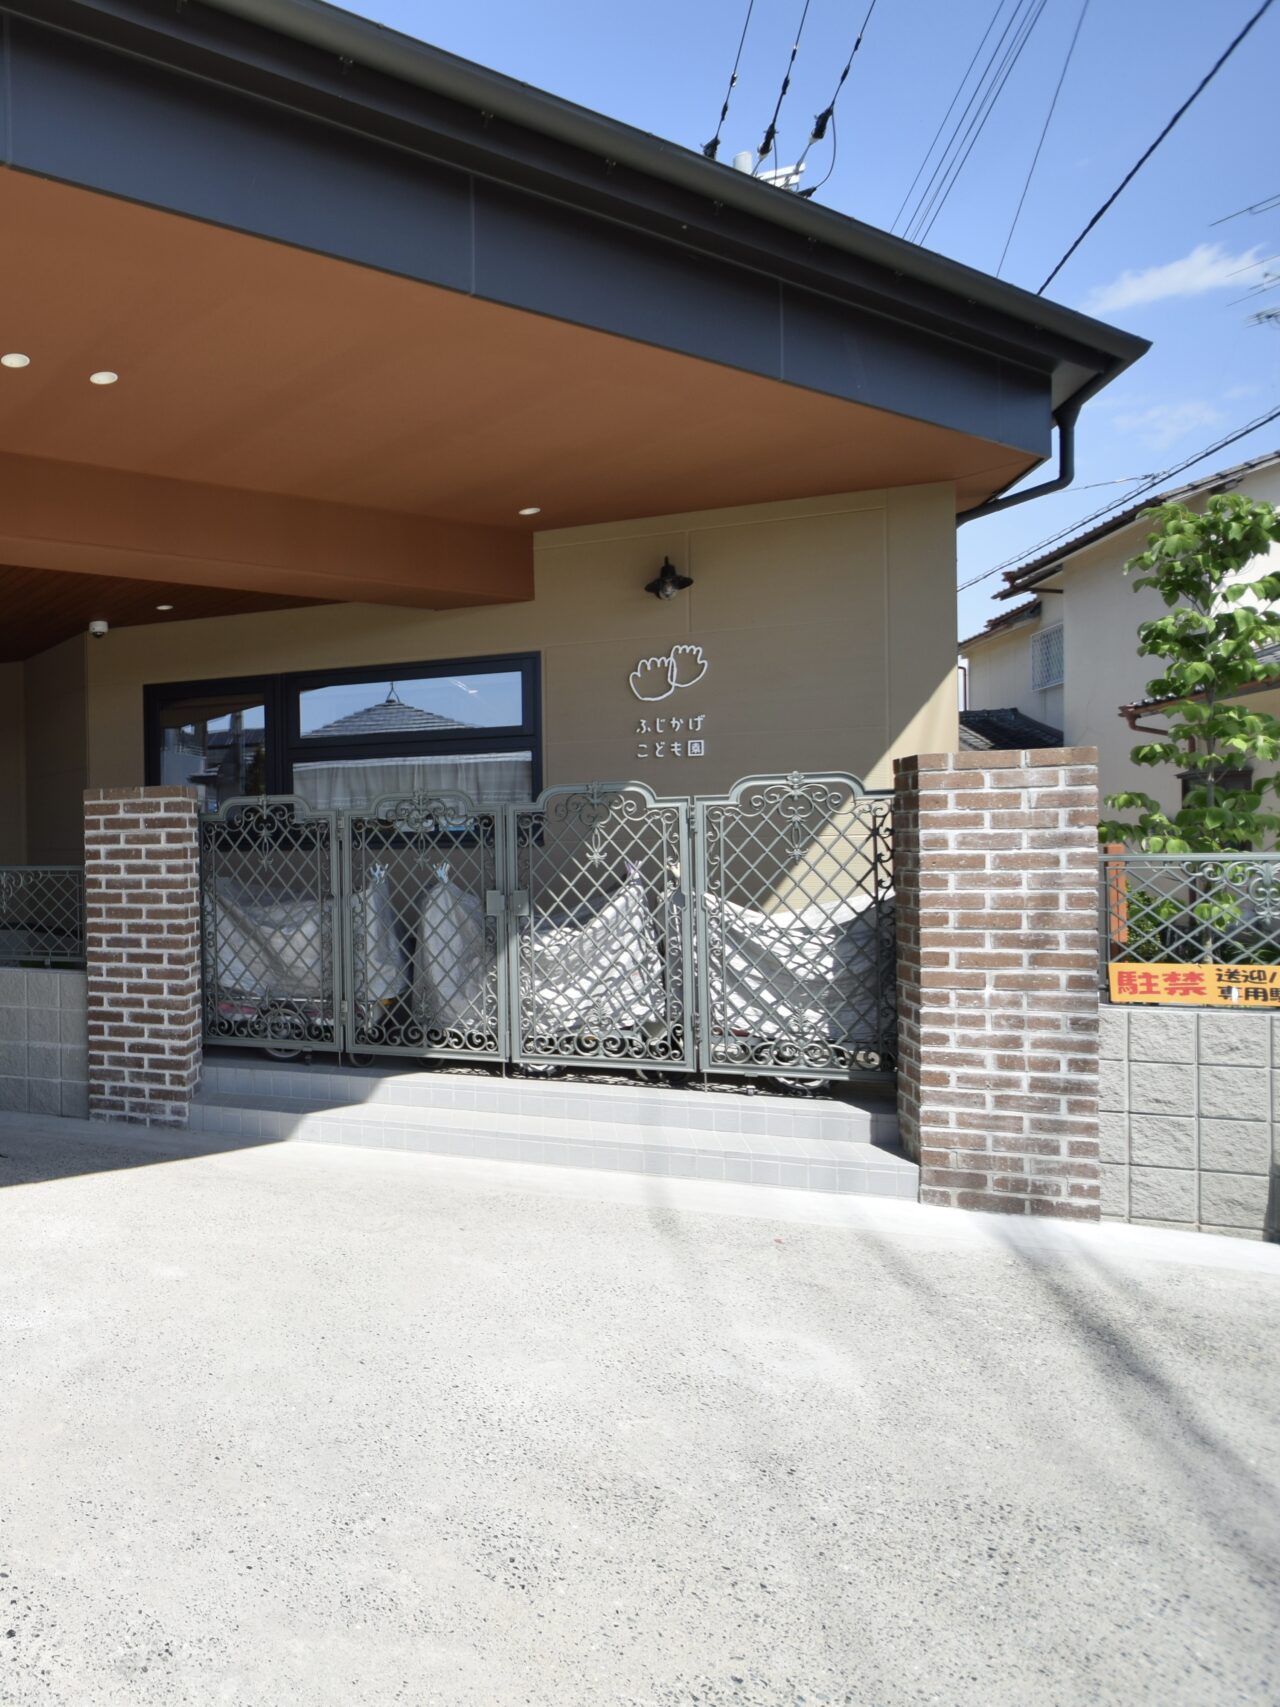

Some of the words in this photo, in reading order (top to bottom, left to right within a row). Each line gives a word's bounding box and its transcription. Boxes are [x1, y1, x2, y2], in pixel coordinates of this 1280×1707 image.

[636, 714, 706, 734] ふじかげ
[637, 740, 705, 758] こども園
[1117, 970, 1208, 997] 駐禁
